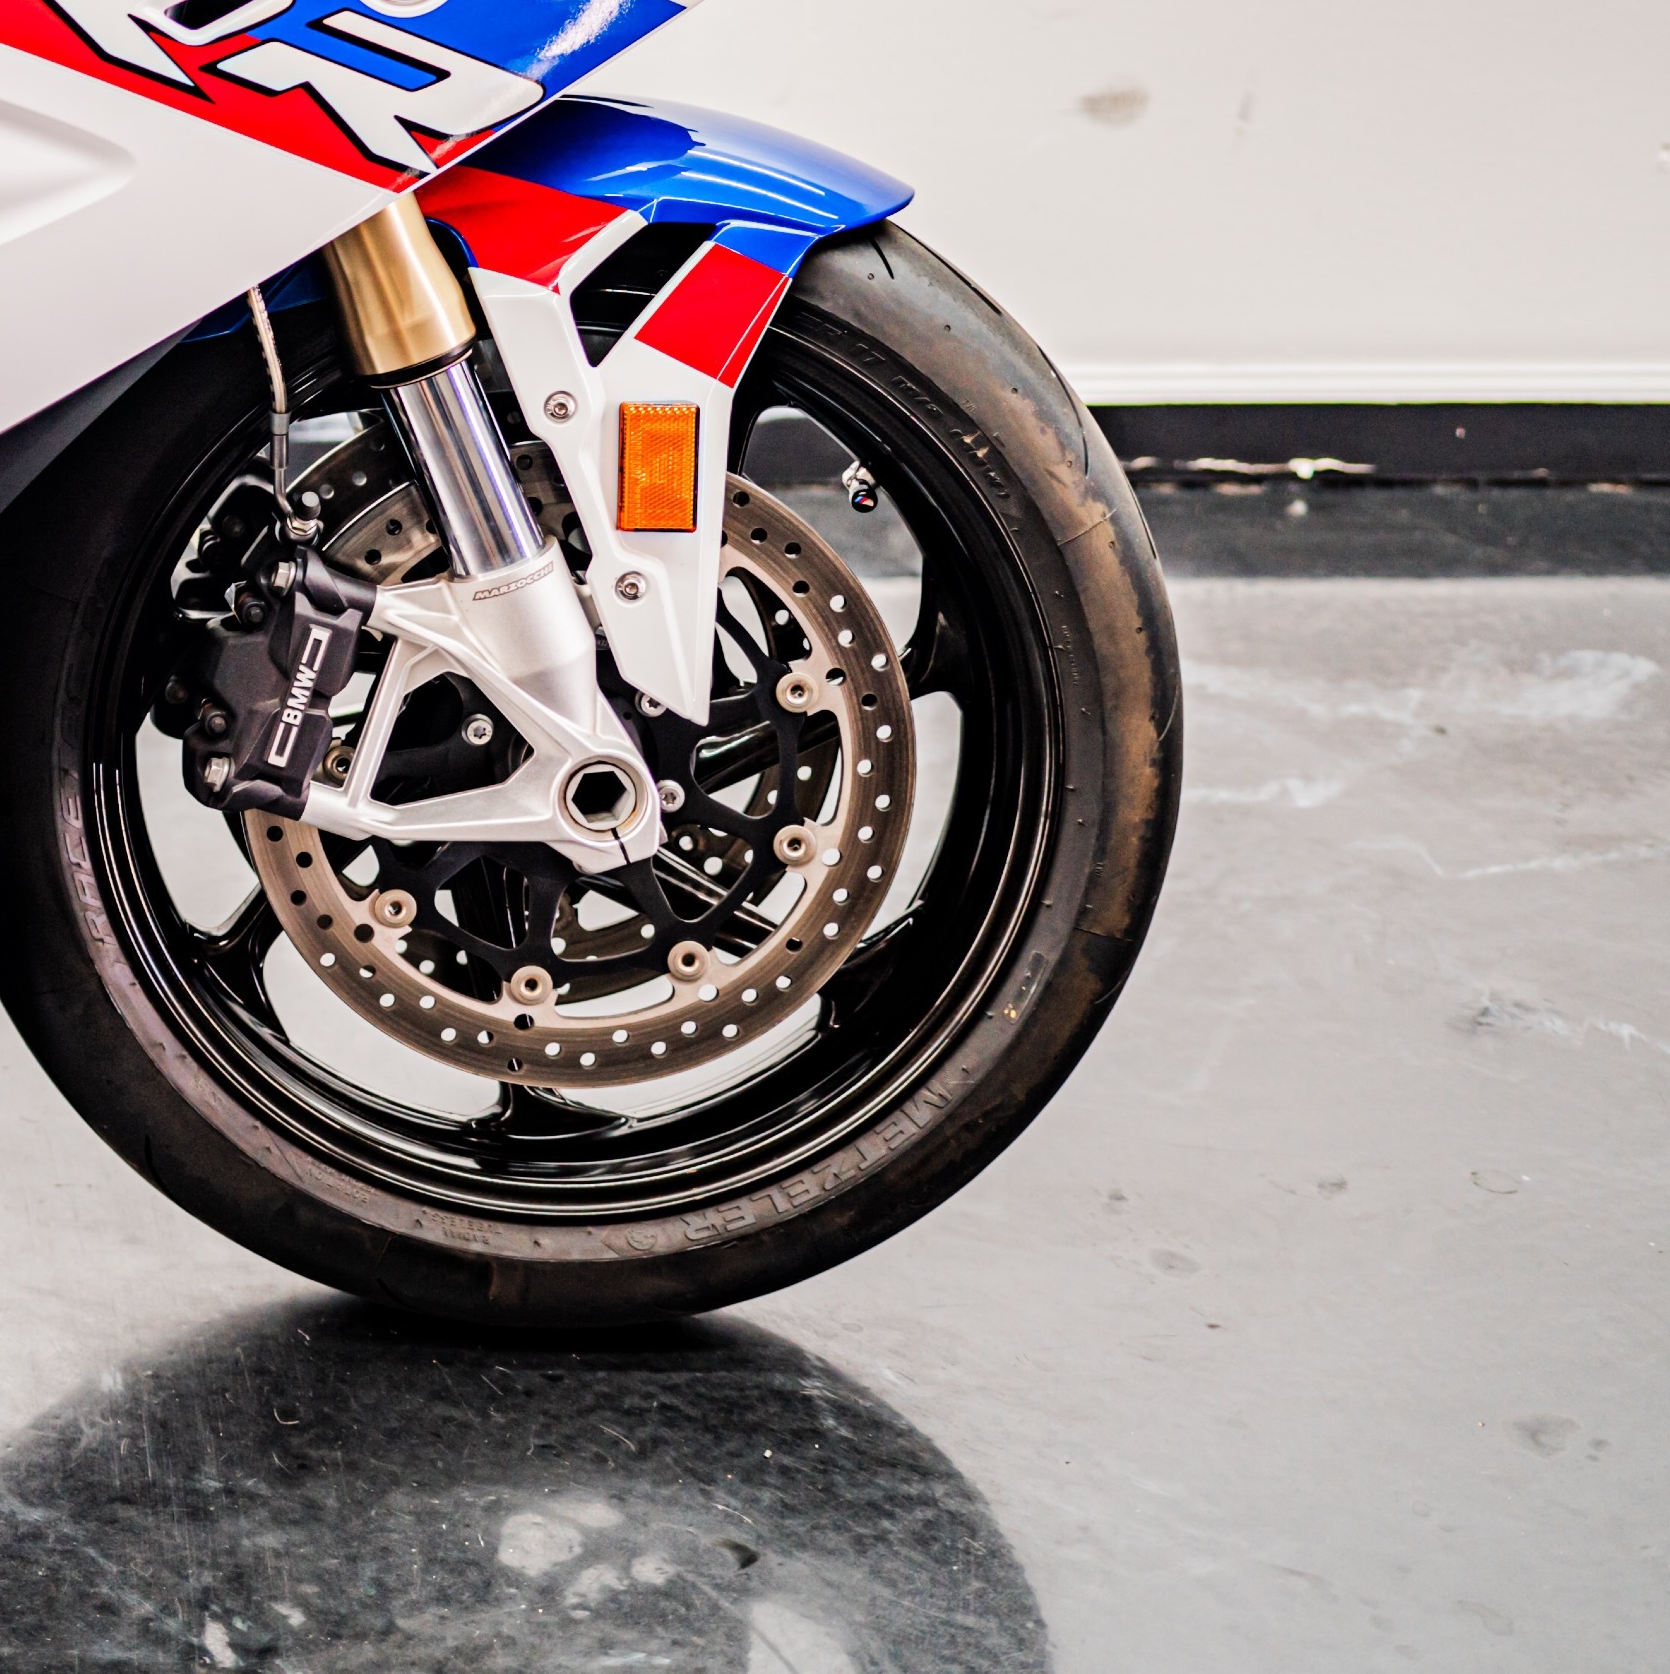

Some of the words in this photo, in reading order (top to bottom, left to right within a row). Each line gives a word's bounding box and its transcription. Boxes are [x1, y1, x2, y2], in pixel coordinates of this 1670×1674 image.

[472, 561, 554, 601] MARZOCCHI
[281, 664, 319, 727] BMW
[677, 1078, 955, 1246] METZELER
